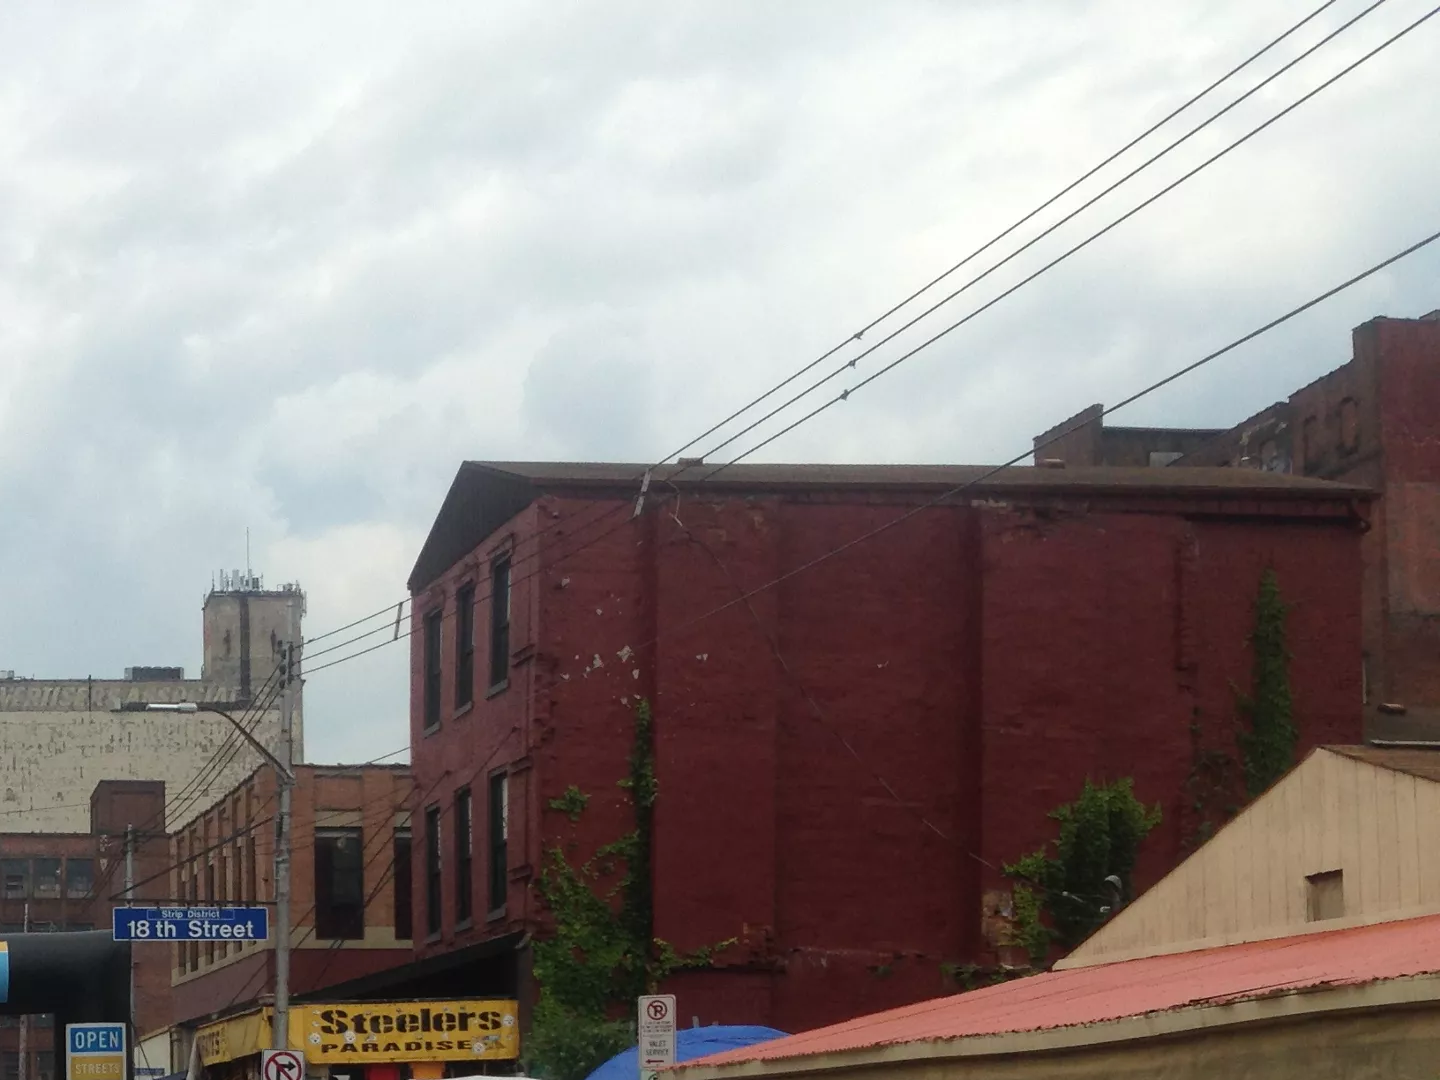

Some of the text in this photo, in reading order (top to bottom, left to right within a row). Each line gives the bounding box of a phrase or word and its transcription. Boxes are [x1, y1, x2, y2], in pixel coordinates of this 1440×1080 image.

[161, 909, 221, 920] Strip District
[127, 920, 150, 938] 18
[188, 920, 254, 938] Street
[320, 1007, 503, 1035] Steelers
[75, 1030, 120, 1049] OPEN
[321, 1039, 474, 1053] PARADISE
[645, 1048, 669, 1056] SERVICE
[75, 1063, 120, 1075] STREETS
